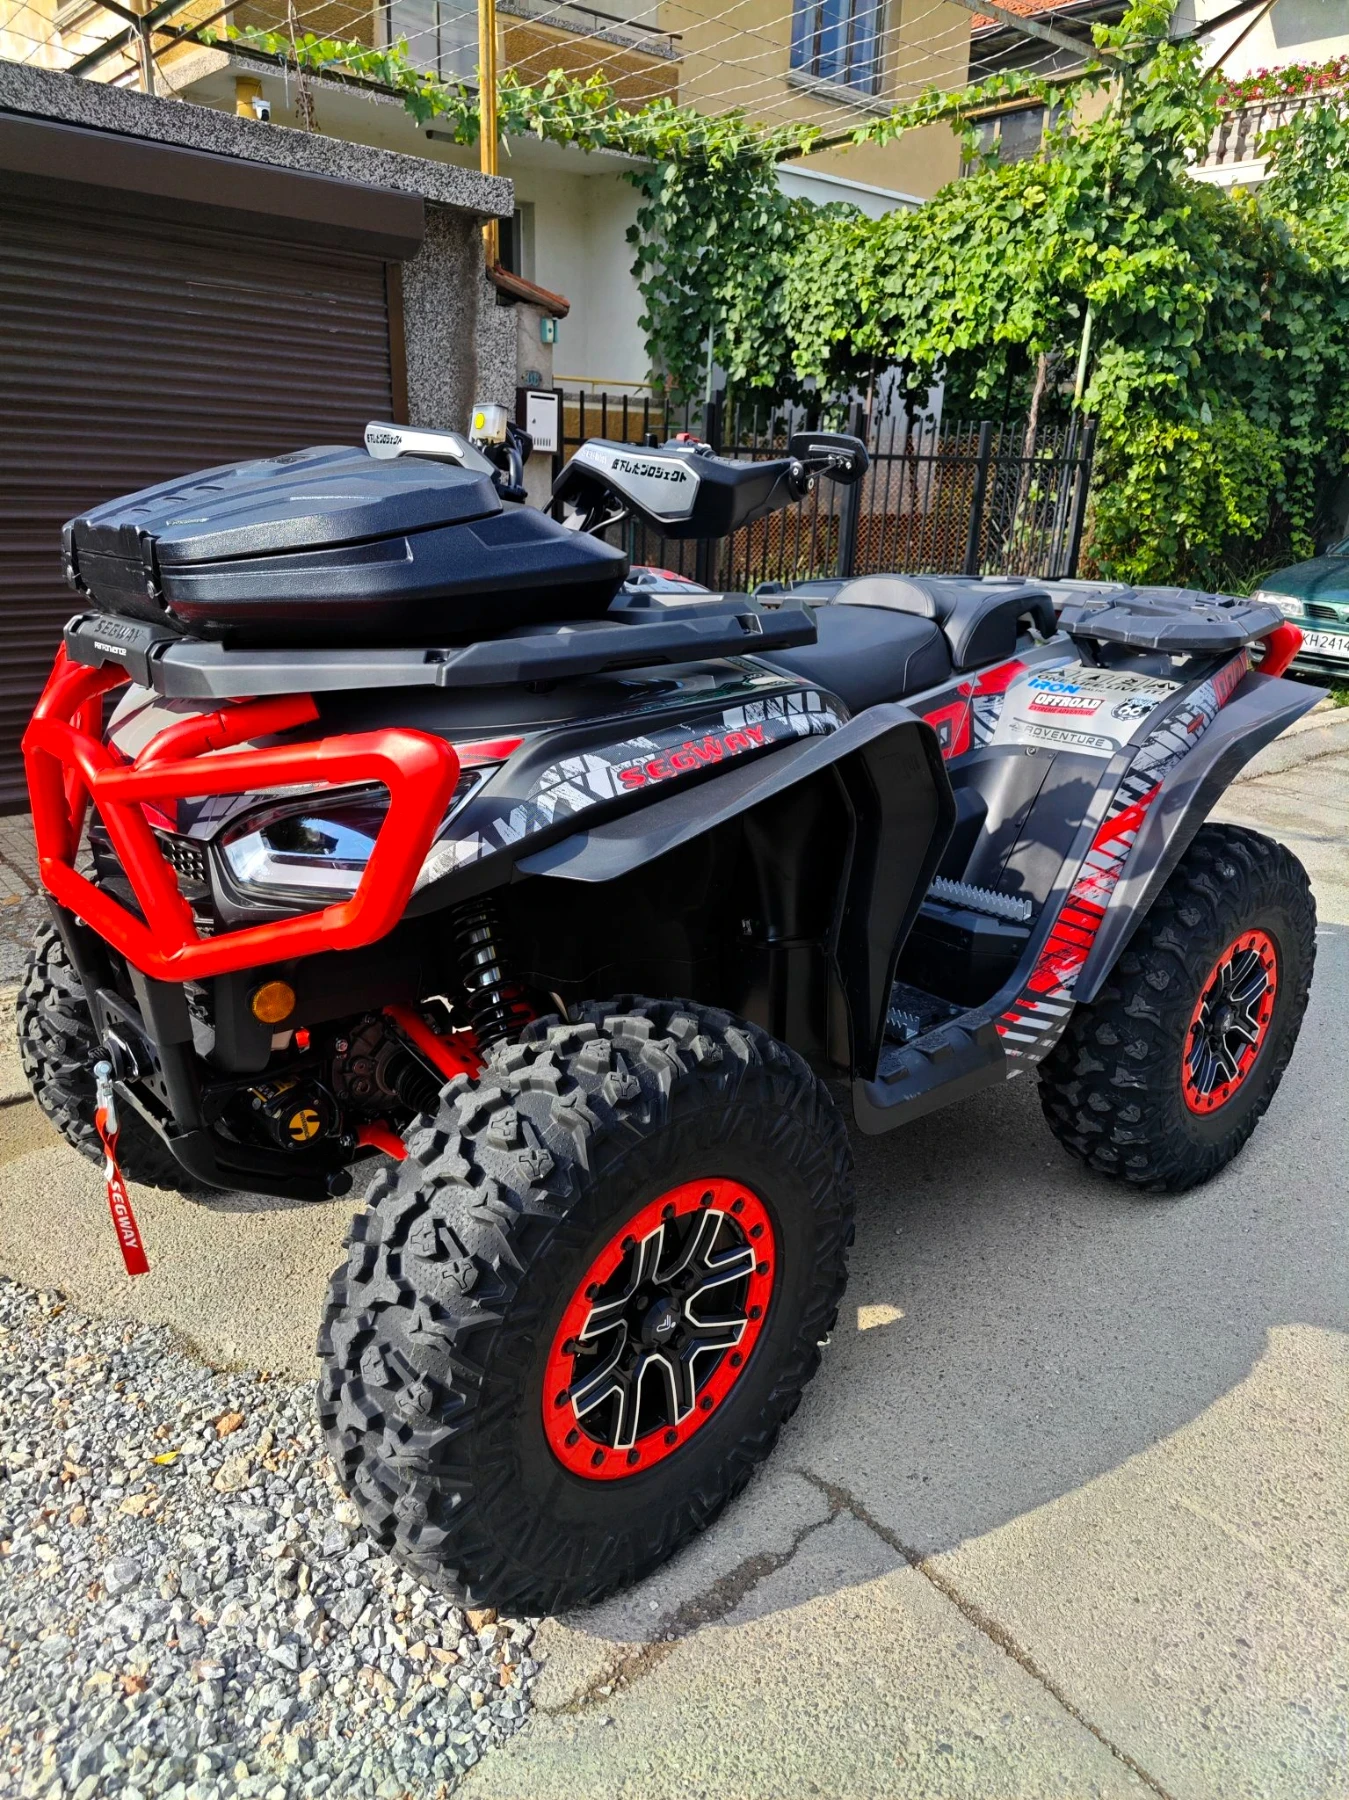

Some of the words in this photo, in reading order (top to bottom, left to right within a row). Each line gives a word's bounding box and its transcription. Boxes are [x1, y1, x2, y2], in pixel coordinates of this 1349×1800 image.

[94, 620, 143, 643] SEGWAY
[1028, 678, 1080, 694] IRON
[1034, 693, 1102, 710] OFFROAD
[1117, 704, 1140, 716] 66
[1023, 725, 1106, 747] ADVENTURE
[618, 724, 766, 790] SEGWAY
[110, 1180, 139, 1248] SEGWAY
